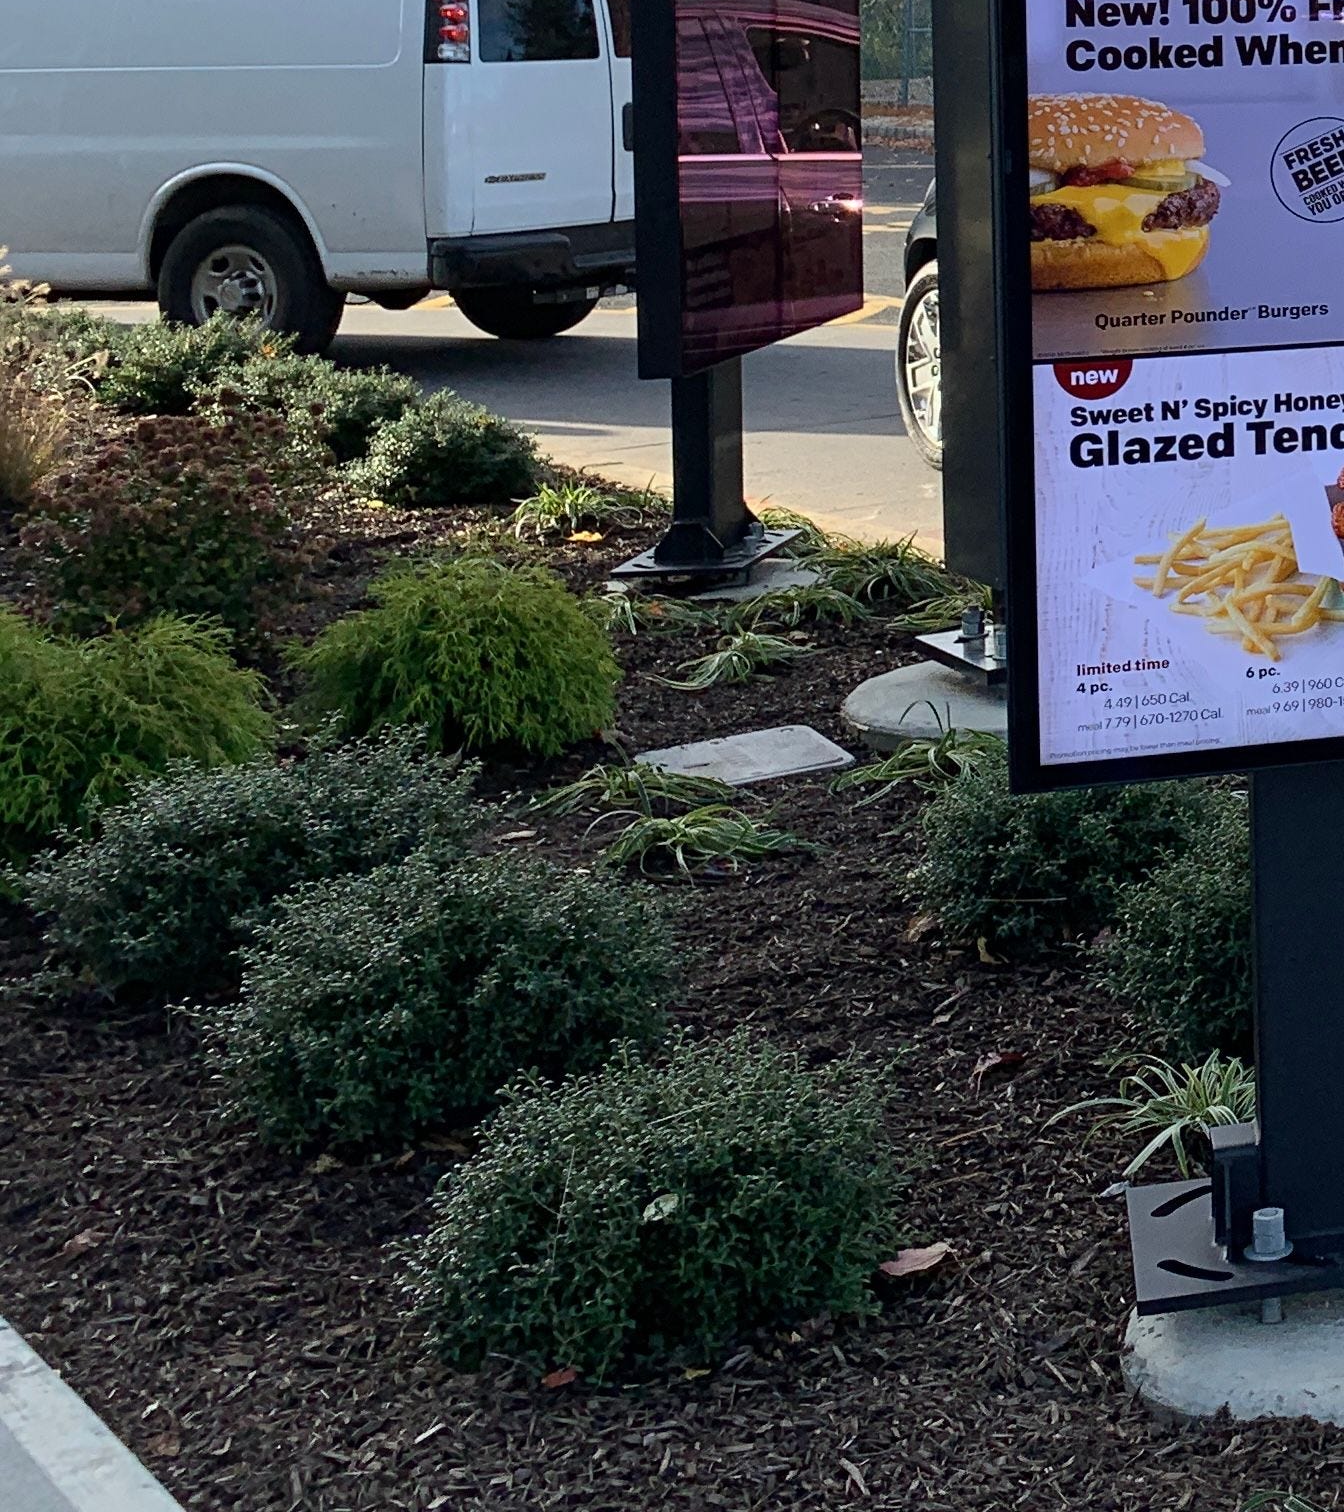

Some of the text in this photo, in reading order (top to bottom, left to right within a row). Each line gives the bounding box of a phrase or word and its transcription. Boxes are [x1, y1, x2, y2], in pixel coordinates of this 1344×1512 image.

[1066, 35, 1223, 71] Cooked
[1303, 183, 1339, 205] COOKED
[1307, 197, 1332, 216] YOU
[1095, 312, 1166, 331] Quarter
[1257, 303, 1329, 320] Burgers
[1070, 368, 1119, 386] new
[1070, 403, 1154, 427] Sweet
[1194, 395, 1268, 421] Spicy
[1070, 422, 1235, 469] Glazed
[1076, 659, 1170, 676] limited time
[1246, 666, 1281, 680] 6 pc.
[1076, 683, 1113, 695] 4 pc.
[1272, 681, 1300, 694] 6.39
[1308, 678, 1332, 691] 960
[1104, 696, 1133, 710] 4.49
[1141, 693, 1167, 707] 650
[1246, 704, 1271, 716] meal
[1140, 710, 1198, 726] 670-1270
